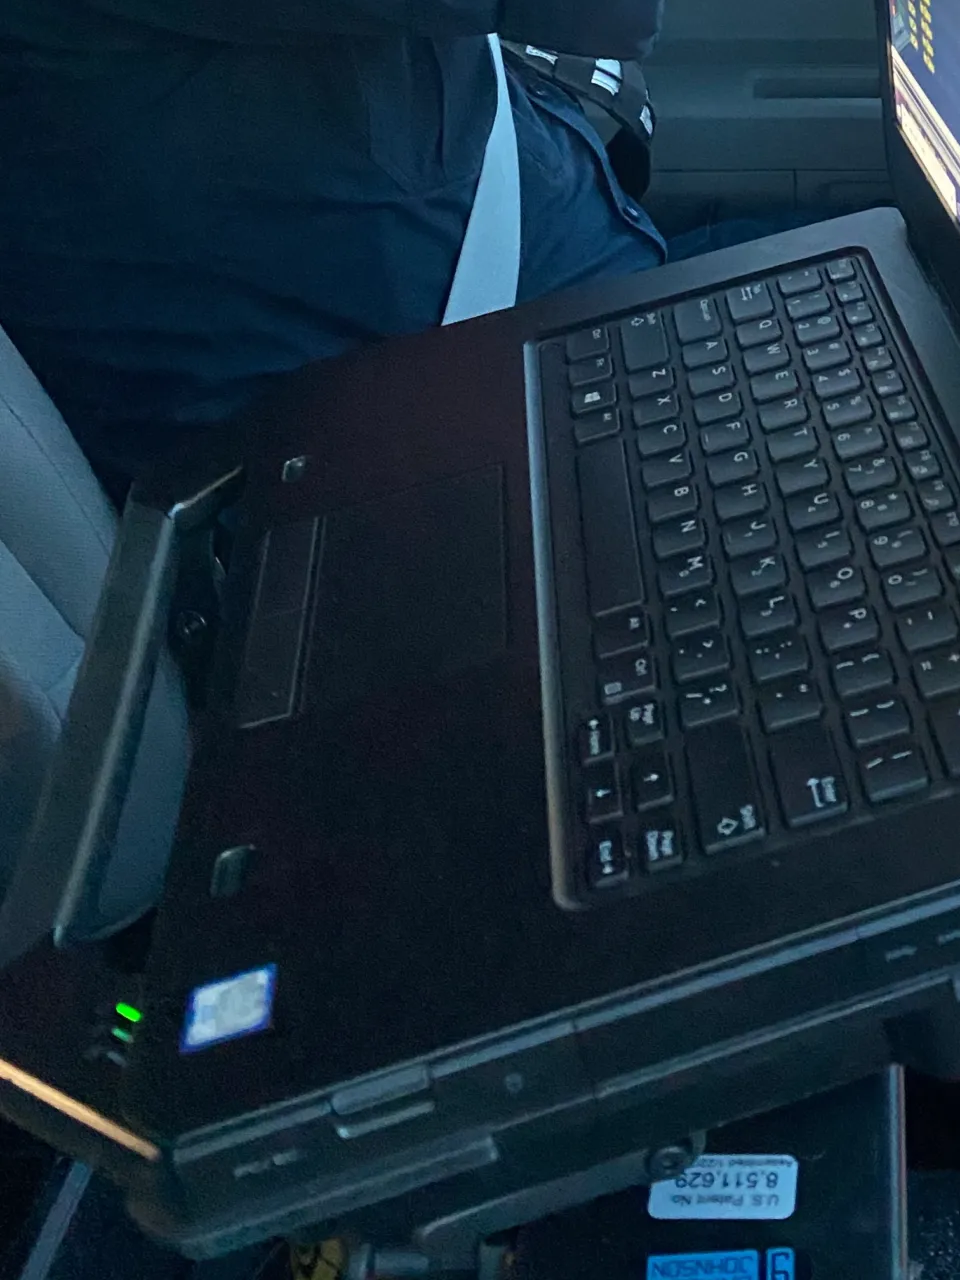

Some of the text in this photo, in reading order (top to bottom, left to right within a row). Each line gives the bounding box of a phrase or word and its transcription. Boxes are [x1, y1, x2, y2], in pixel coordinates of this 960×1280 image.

[705, 340, 719, 351] A
[767, 343, 780, 354] W
[652, 368, 666, 378] Z
[712, 366, 726, 375] S
[775, 371, 788, 380] E
[657, 396, 670, 405] X
[718, 393, 732, 402] D
[784, 399, 797, 408] R
[663, 424, 677, 434] C
[794, 428, 807, 436] T
[669, 454, 682, 462] V
[734, 452, 748, 462] G
[804, 459, 818, 467] Y
[674, 487, 689, 496] B
[742, 484, 756, 496] H
[814, 493, 828, 504] U
[682, 520, 695, 532] N
[751, 521, 765, 529] J
[688, 556, 702, 570] M
[760, 557, 775, 568] K
[837, 568, 853, 579] O
[769, 596, 784, 608] L
[850, 608, 866, 619] P
[675, 1171, 778, 1188] 8,511,629
[698, 1194, 743, 1205] Patent
[652, 1257, 752, 1276] JOHNSON
